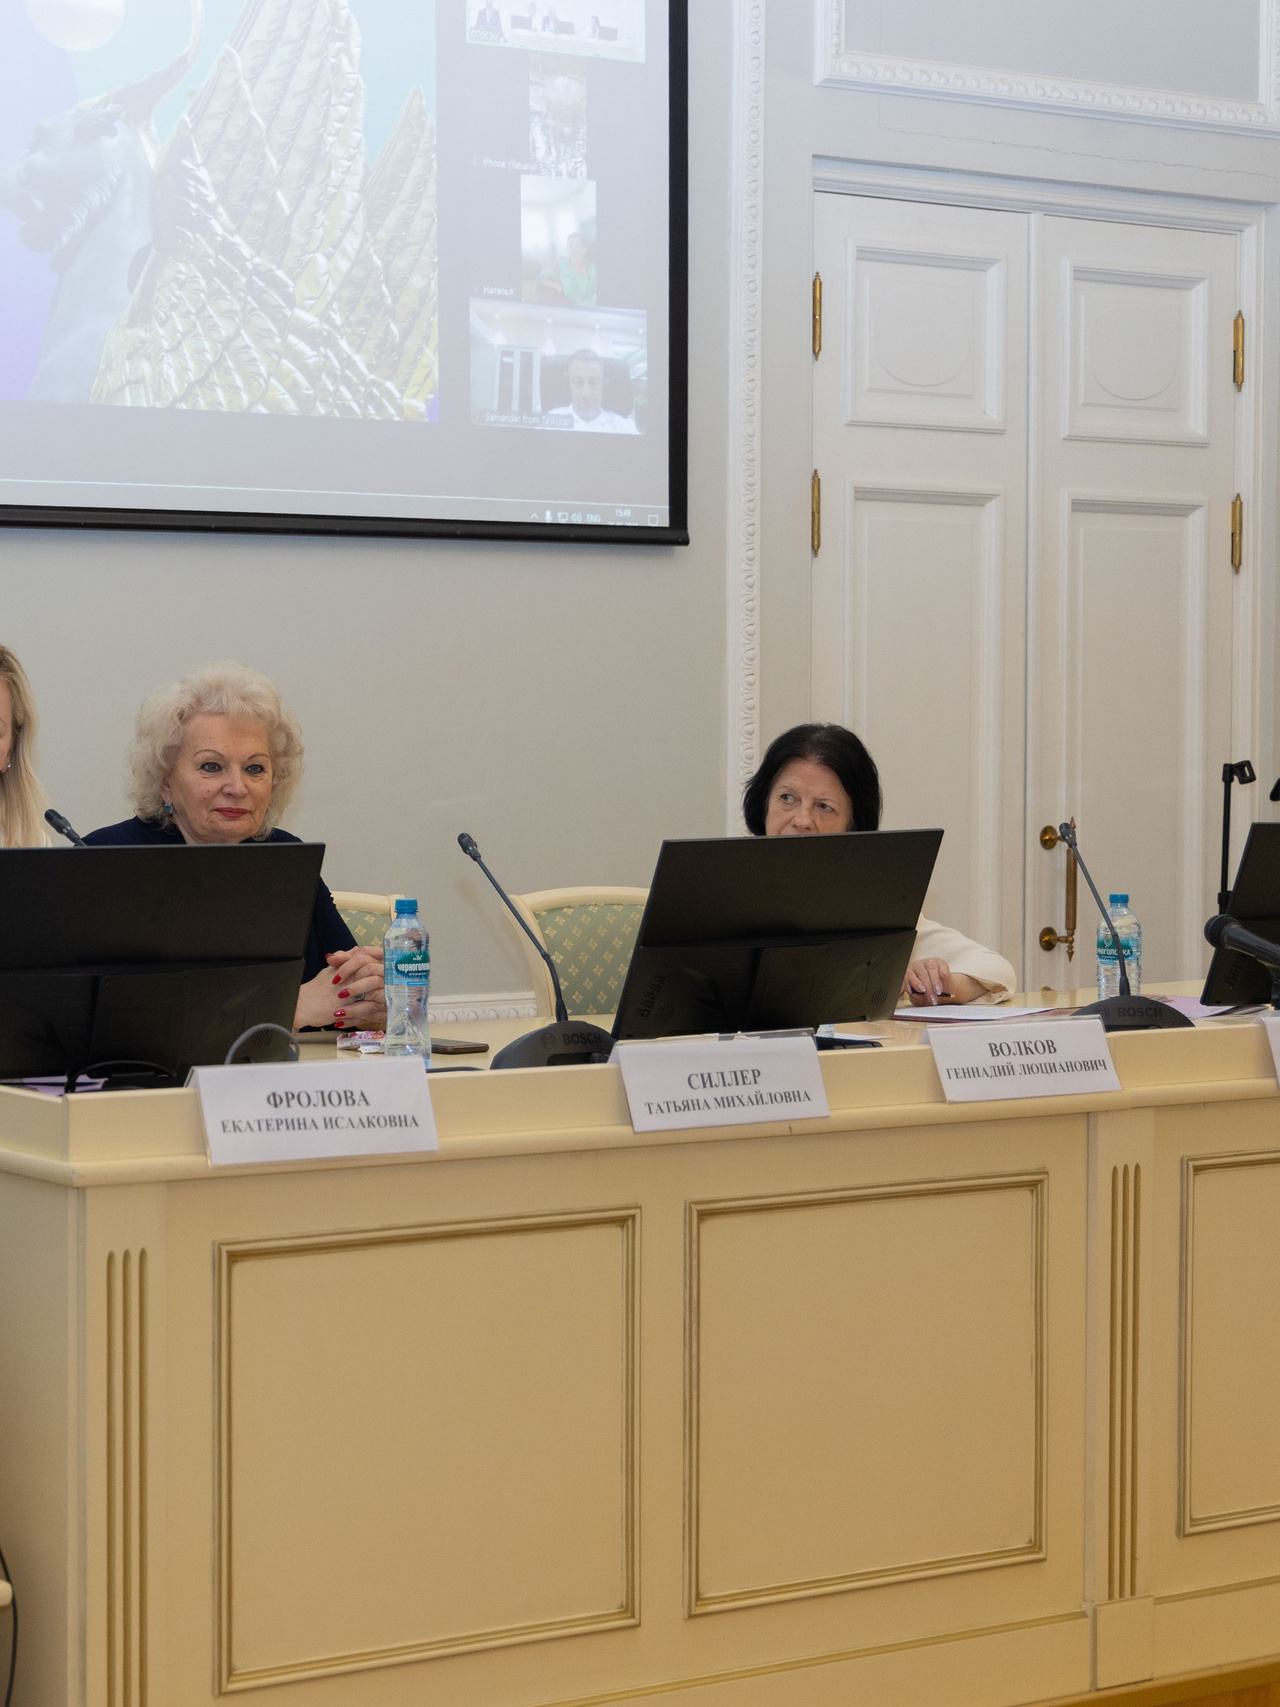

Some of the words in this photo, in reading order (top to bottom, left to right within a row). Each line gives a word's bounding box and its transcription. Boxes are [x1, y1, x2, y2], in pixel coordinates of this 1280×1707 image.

[482, 158, 507, 168] iPhone
[522, 414, 539, 424] from
[586, 513, 601, 523] ENG
[1117, 1007, 1162, 1018] BOSCH
[562, 1031, 602, 1045] BOSCH
[988, 1039, 1057, 1057] ВОЛКОВ
[946, 1062, 1015, 1079] ГЕННАДИЙ
[1019, 1059, 1108, 1076] ЛЮЦИАНОВИЧ
[687, 1068, 761, 1090] СИЛЛЕР
[266, 1089, 370, 1109] ФРОЛОВА
[644, 1101, 711, 1115] ТАТЬЯНА
[714, 1090, 811, 1109] МИХАЙЛОВНА
[221, 1117, 319, 1133] ЕКАТЕРИНА
[323, 1115, 419, 1130] ИСААКОВНА
